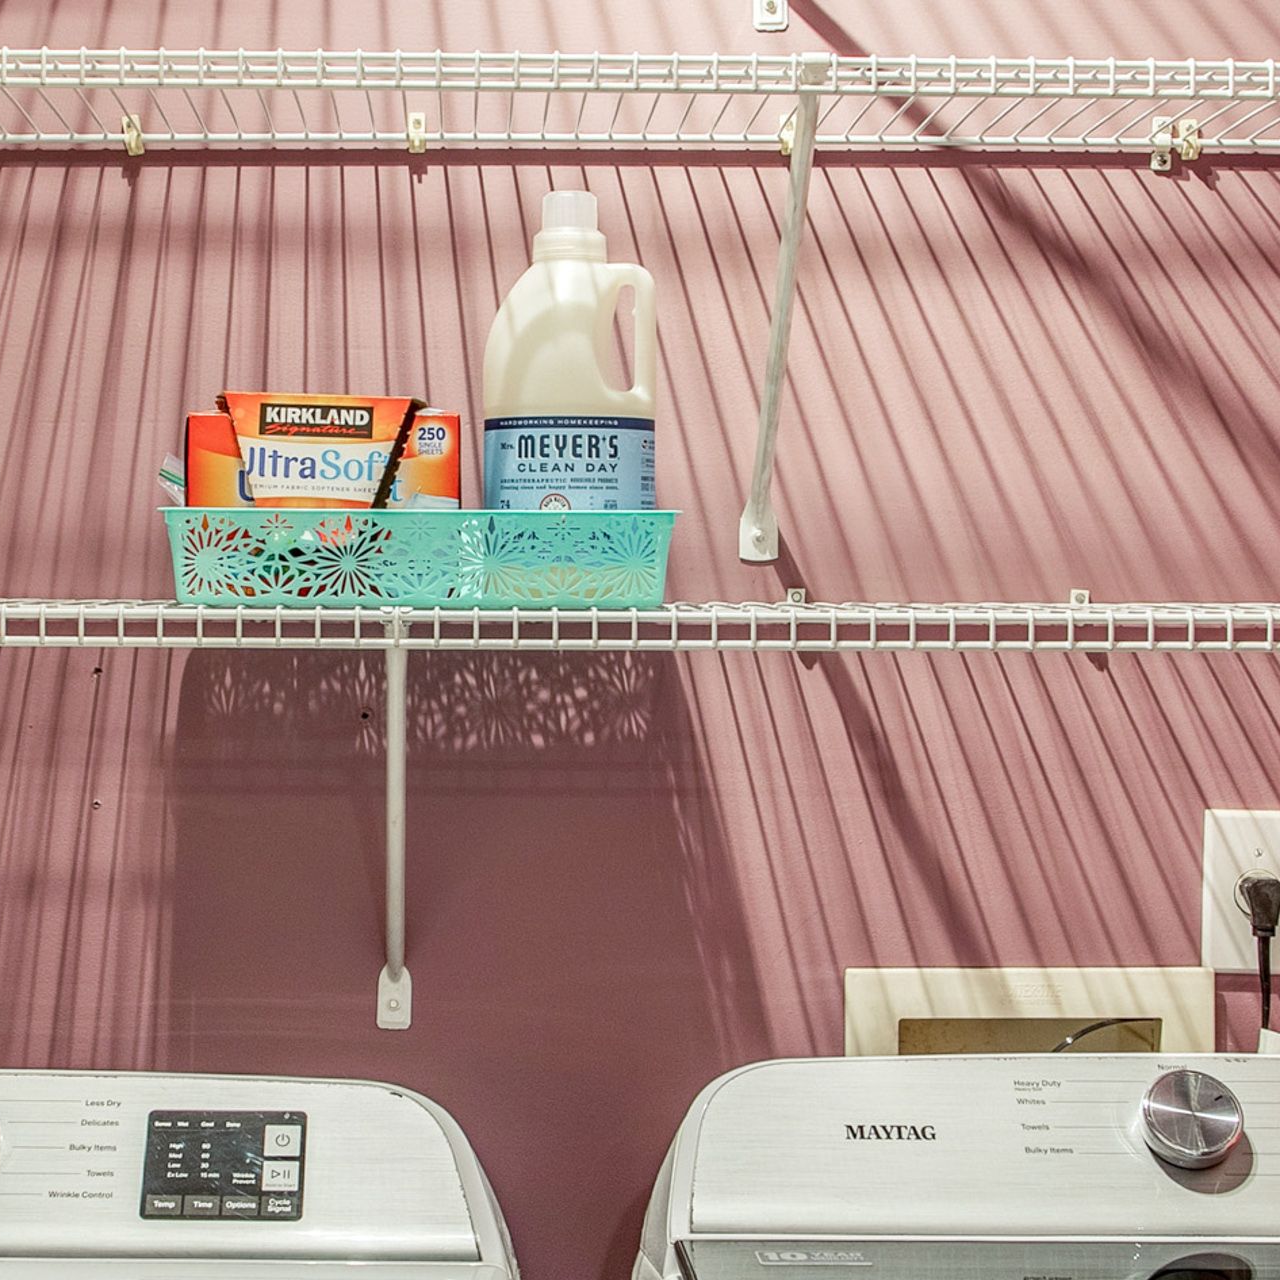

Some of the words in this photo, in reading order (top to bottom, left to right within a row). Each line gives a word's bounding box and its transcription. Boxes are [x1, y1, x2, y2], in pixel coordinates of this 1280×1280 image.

[265, 407, 370, 425] KIRKLAND
[417, 427, 446, 441] 250
[500, 441, 515, 450] Mrs.
[517, 434, 620, 459] MEYER'S
[517, 462, 575, 473] CLEAN
[585, 462, 619, 473] DAY
[107, 1100, 122, 1108] Dry
[80, 1119, 120, 1127] Delicates
[844, 1124, 936, 1140] MAYTAG
[69, 1144, 92, 1153] Bulky
[94, 1144, 117, 1152] Items
[1025, 1146, 1048, 1155] Bulky
[86, 1170, 115, 1178] Towels
[48, 1191, 80, 1199] Wrinkle
[81, 1191, 113, 1199] Control
[153, 1200, 176, 1209] Temp
[192, 1200, 213, 1208] Time
[225, 1200, 256, 1210] Options
[268, 1198, 291, 1207] Cycle
